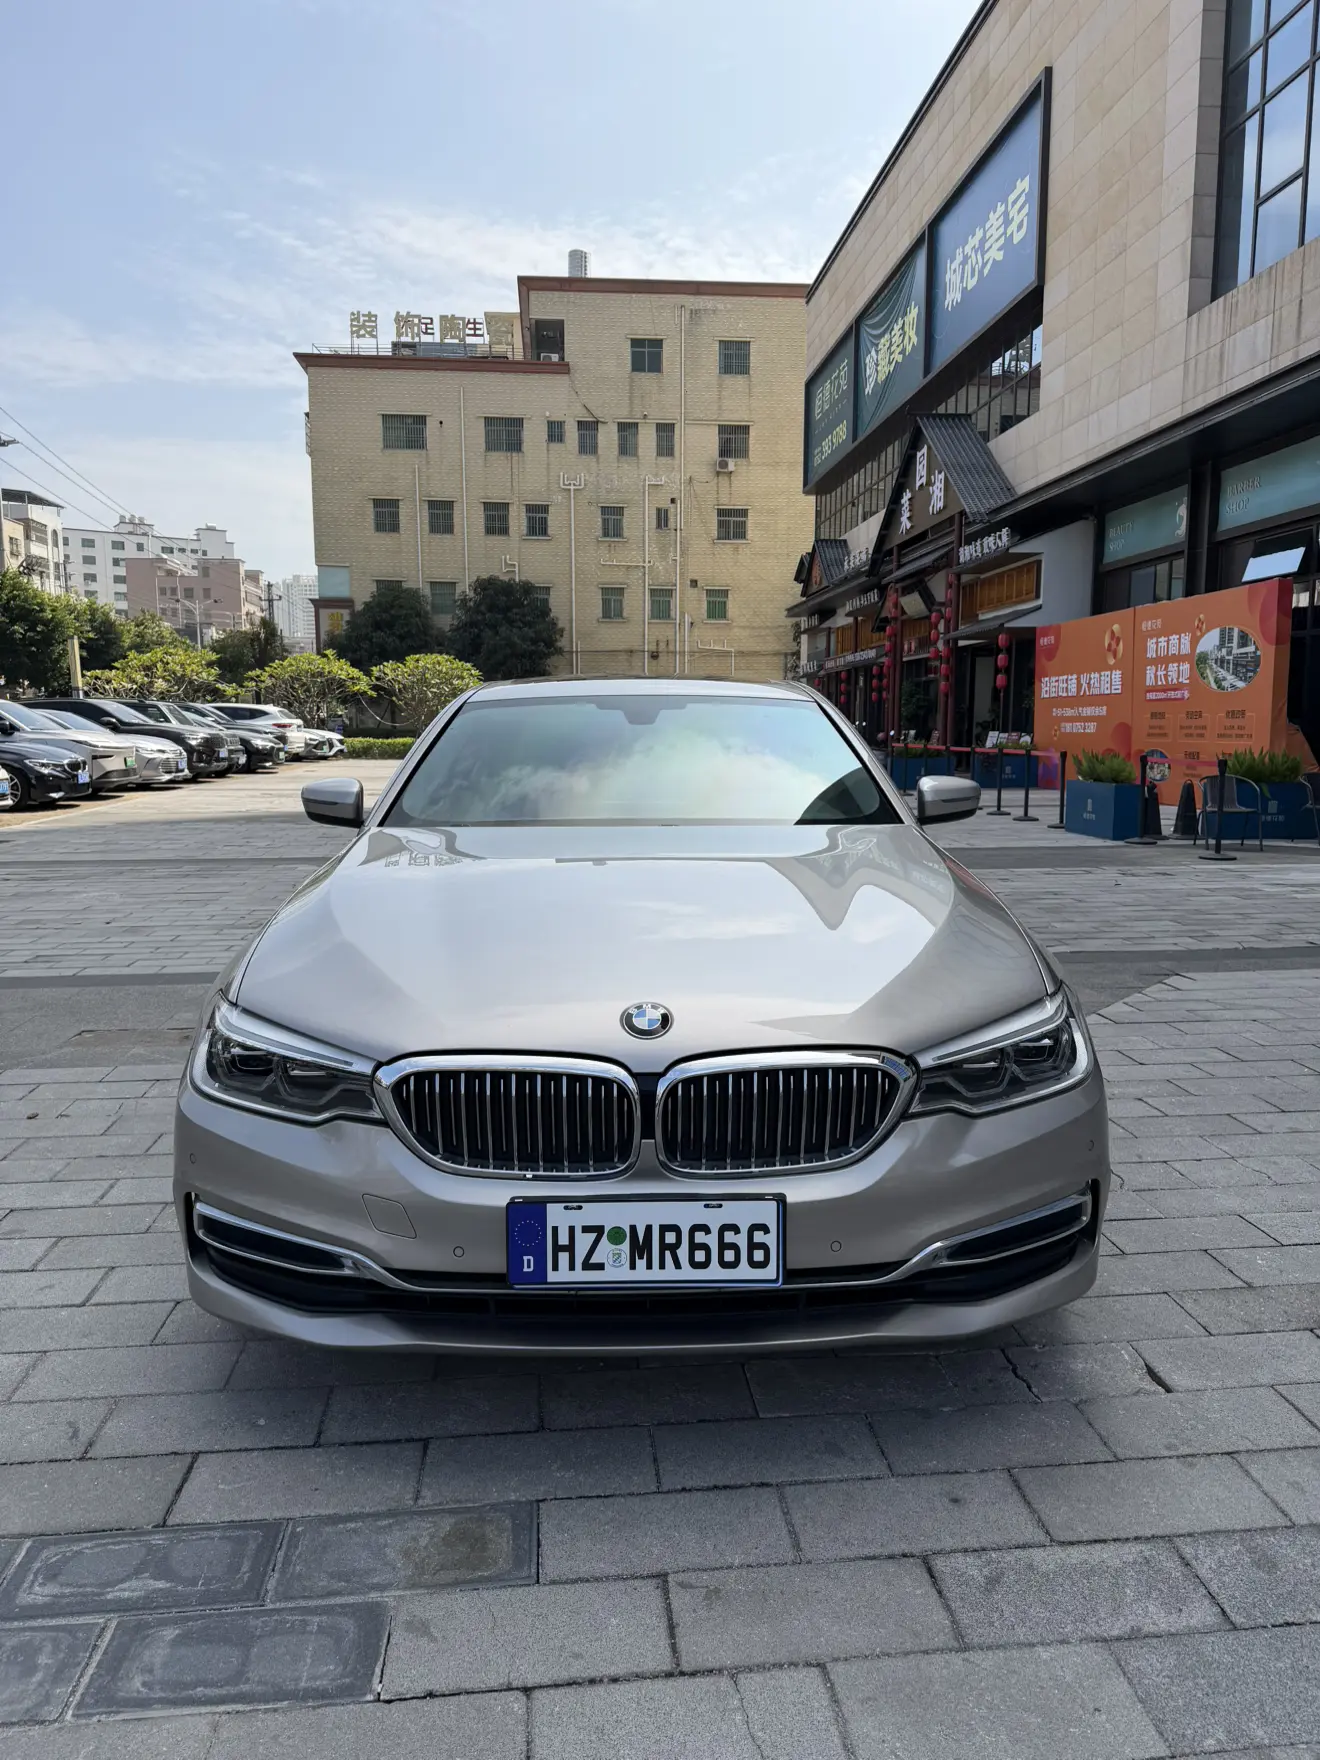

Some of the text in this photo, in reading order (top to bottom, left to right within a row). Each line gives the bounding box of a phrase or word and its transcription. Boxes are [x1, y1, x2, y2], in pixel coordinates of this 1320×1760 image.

[944, 174, 1030, 312] 城芯美宅
[350, 310, 514, 346] 装饰陶瓷
[1227, 477, 1261, 497] BARBER
[1225, 498, 1250, 514] SHOP
[1147, 632, 1192, 659] 城市商脉
[1041, 670, 1122, 699] 沿街旺铺 火热租售
[1146, 661, 1190, 687] 秋长领地
[551, 1222, 771, 1272] HZ MR666
[522, 1255, 534, 1272] D
